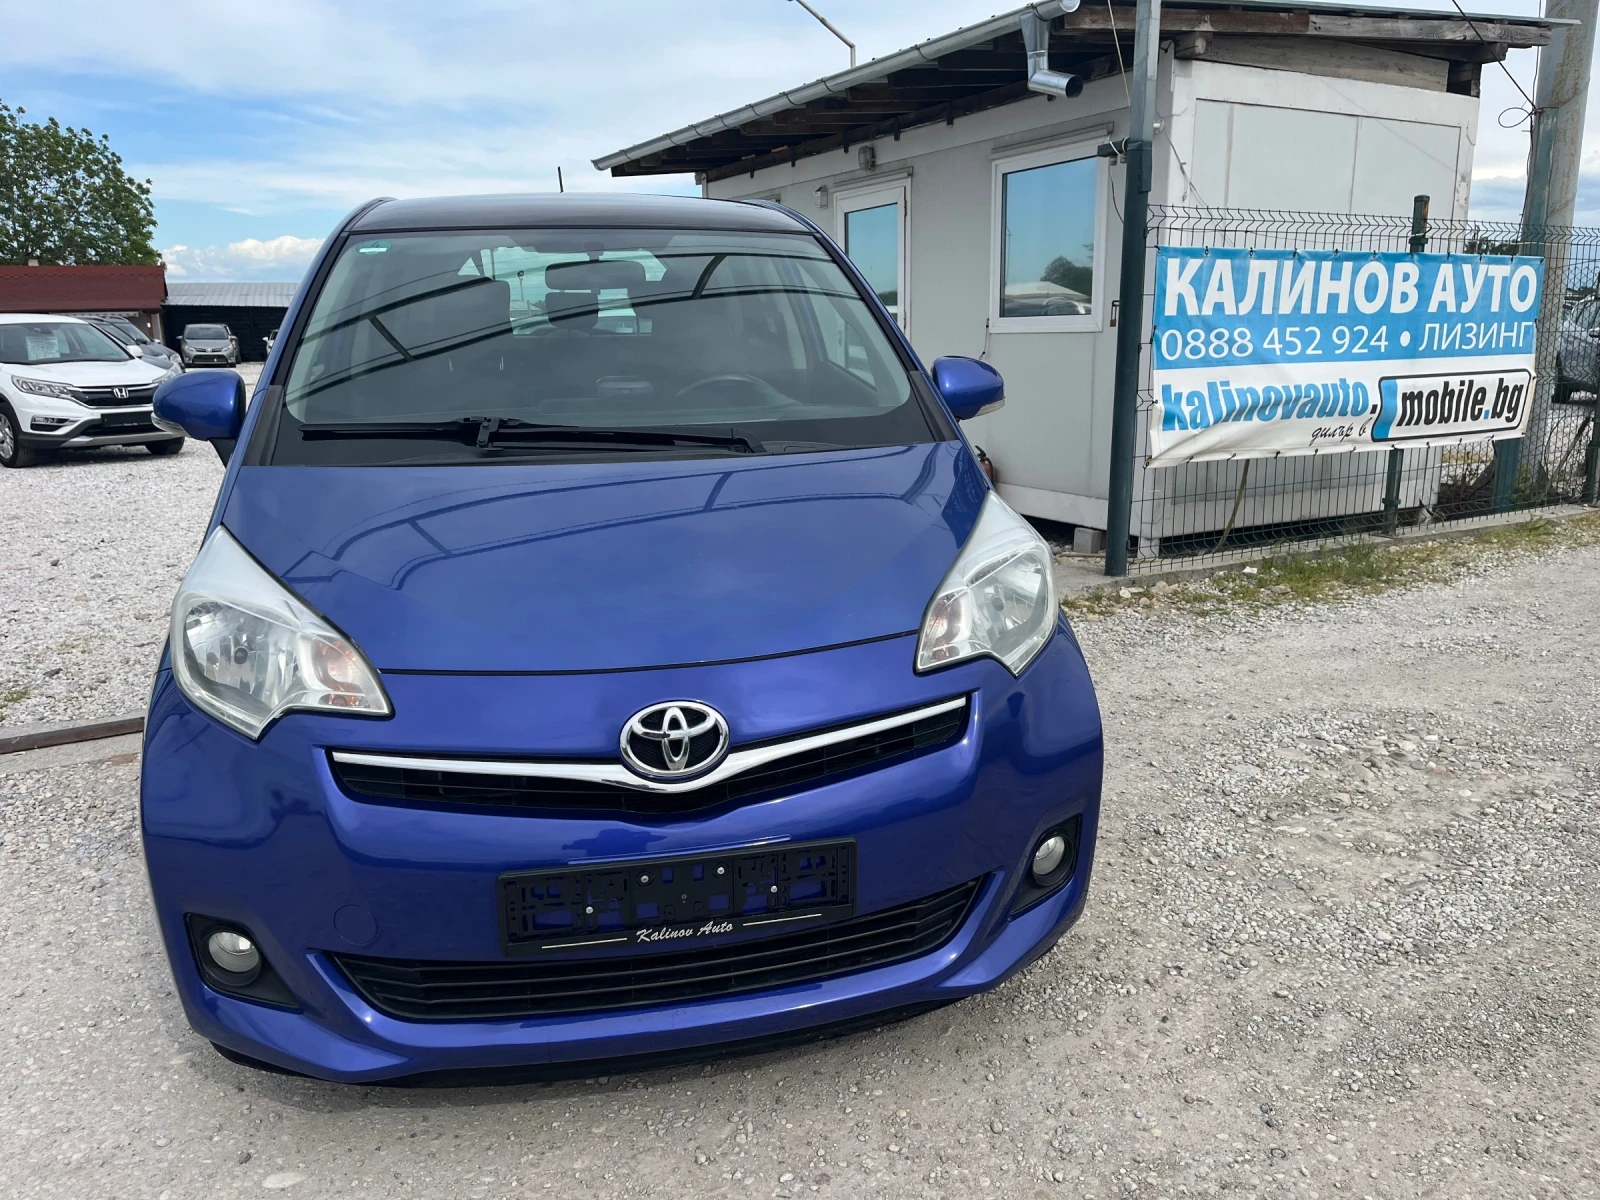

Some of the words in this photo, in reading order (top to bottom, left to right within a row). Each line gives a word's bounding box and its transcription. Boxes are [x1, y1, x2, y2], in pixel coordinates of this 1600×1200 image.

[1163, 258, 1419, 317] КАЛИНОВ
[1428, 264, 1538, 313] АУТО
[1161, 327, 1254, 361] 0888
[1262, 326, 1323, 356] 452
[1333, 324, 1389, 353] 924
[1418, 321, 1535, 352] ЛИЗИНГ
[1396, 379, 1525, 428] mobile.bg
[636, 927, 694, 943] Kalinov
[696, 920, 734, 937] Auto
